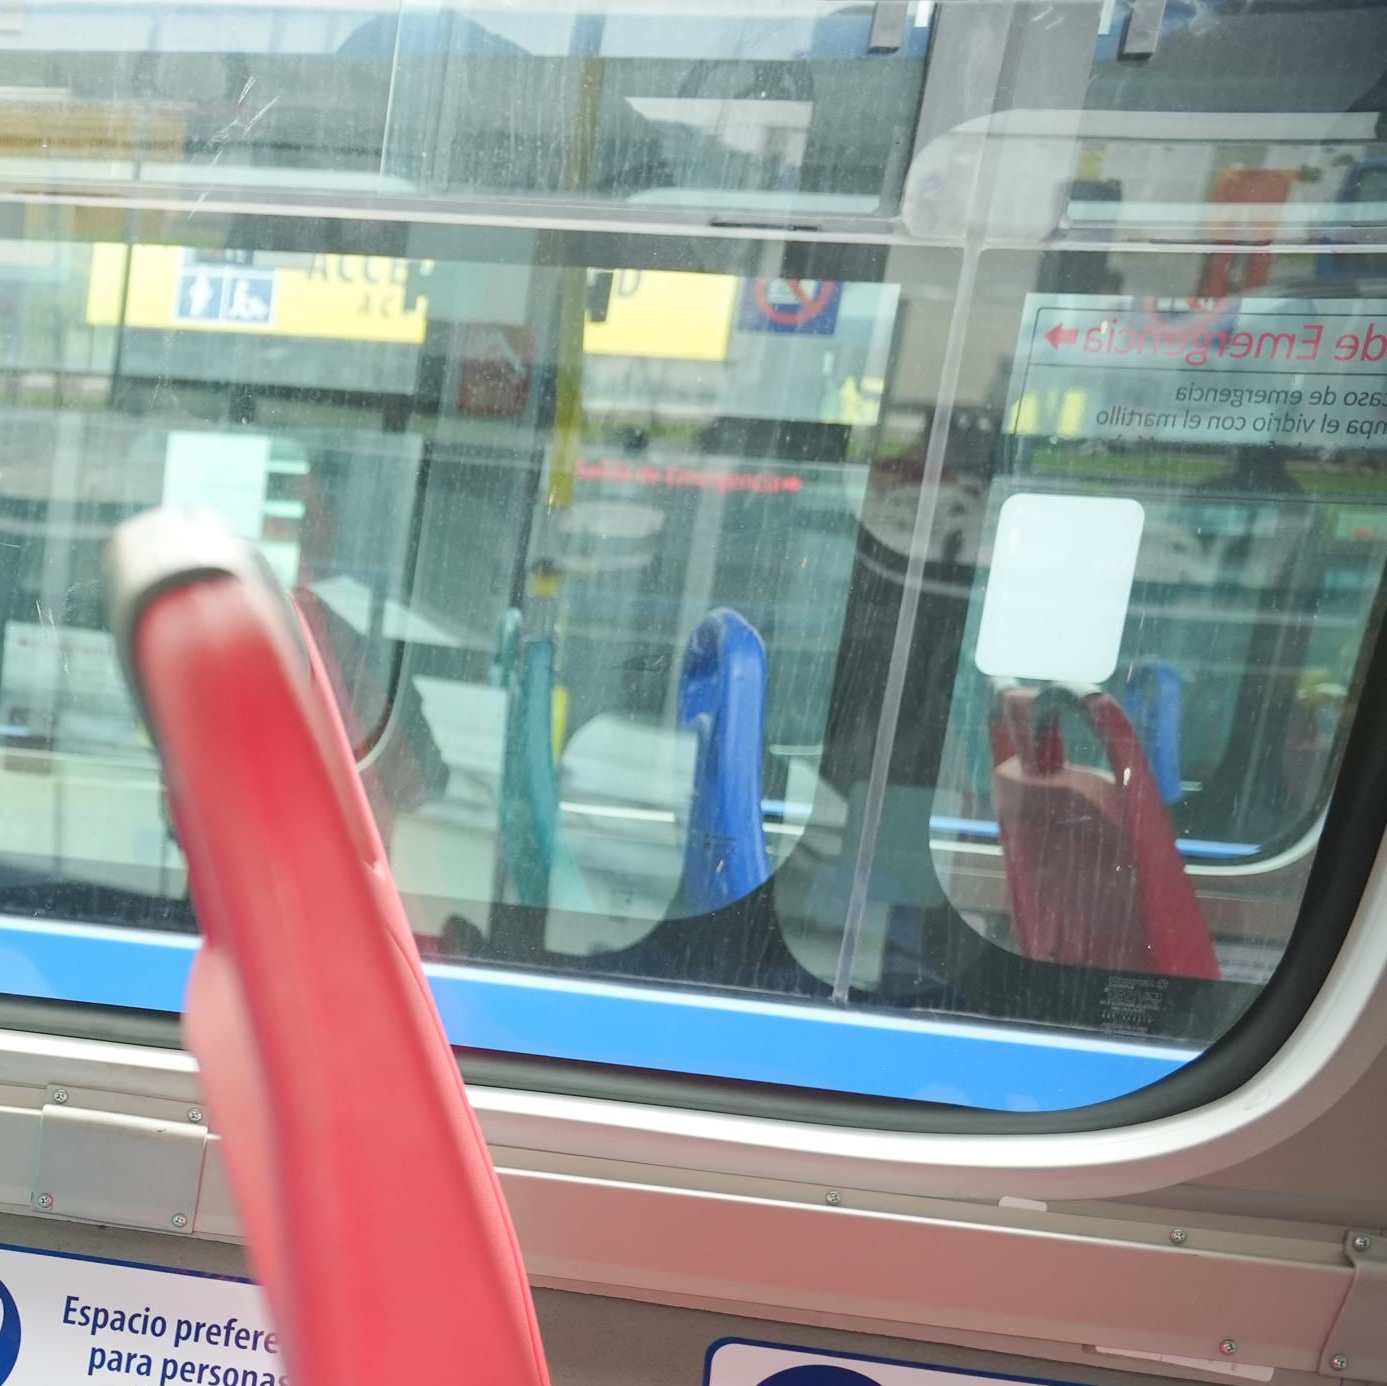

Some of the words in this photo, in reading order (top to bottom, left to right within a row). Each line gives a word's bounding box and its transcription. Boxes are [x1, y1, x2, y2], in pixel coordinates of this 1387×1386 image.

[62, 1295, 167, 1336] Espacio
[173, 1317, 280, 1355] prefere
[87, 1346, 153, 1377] para
